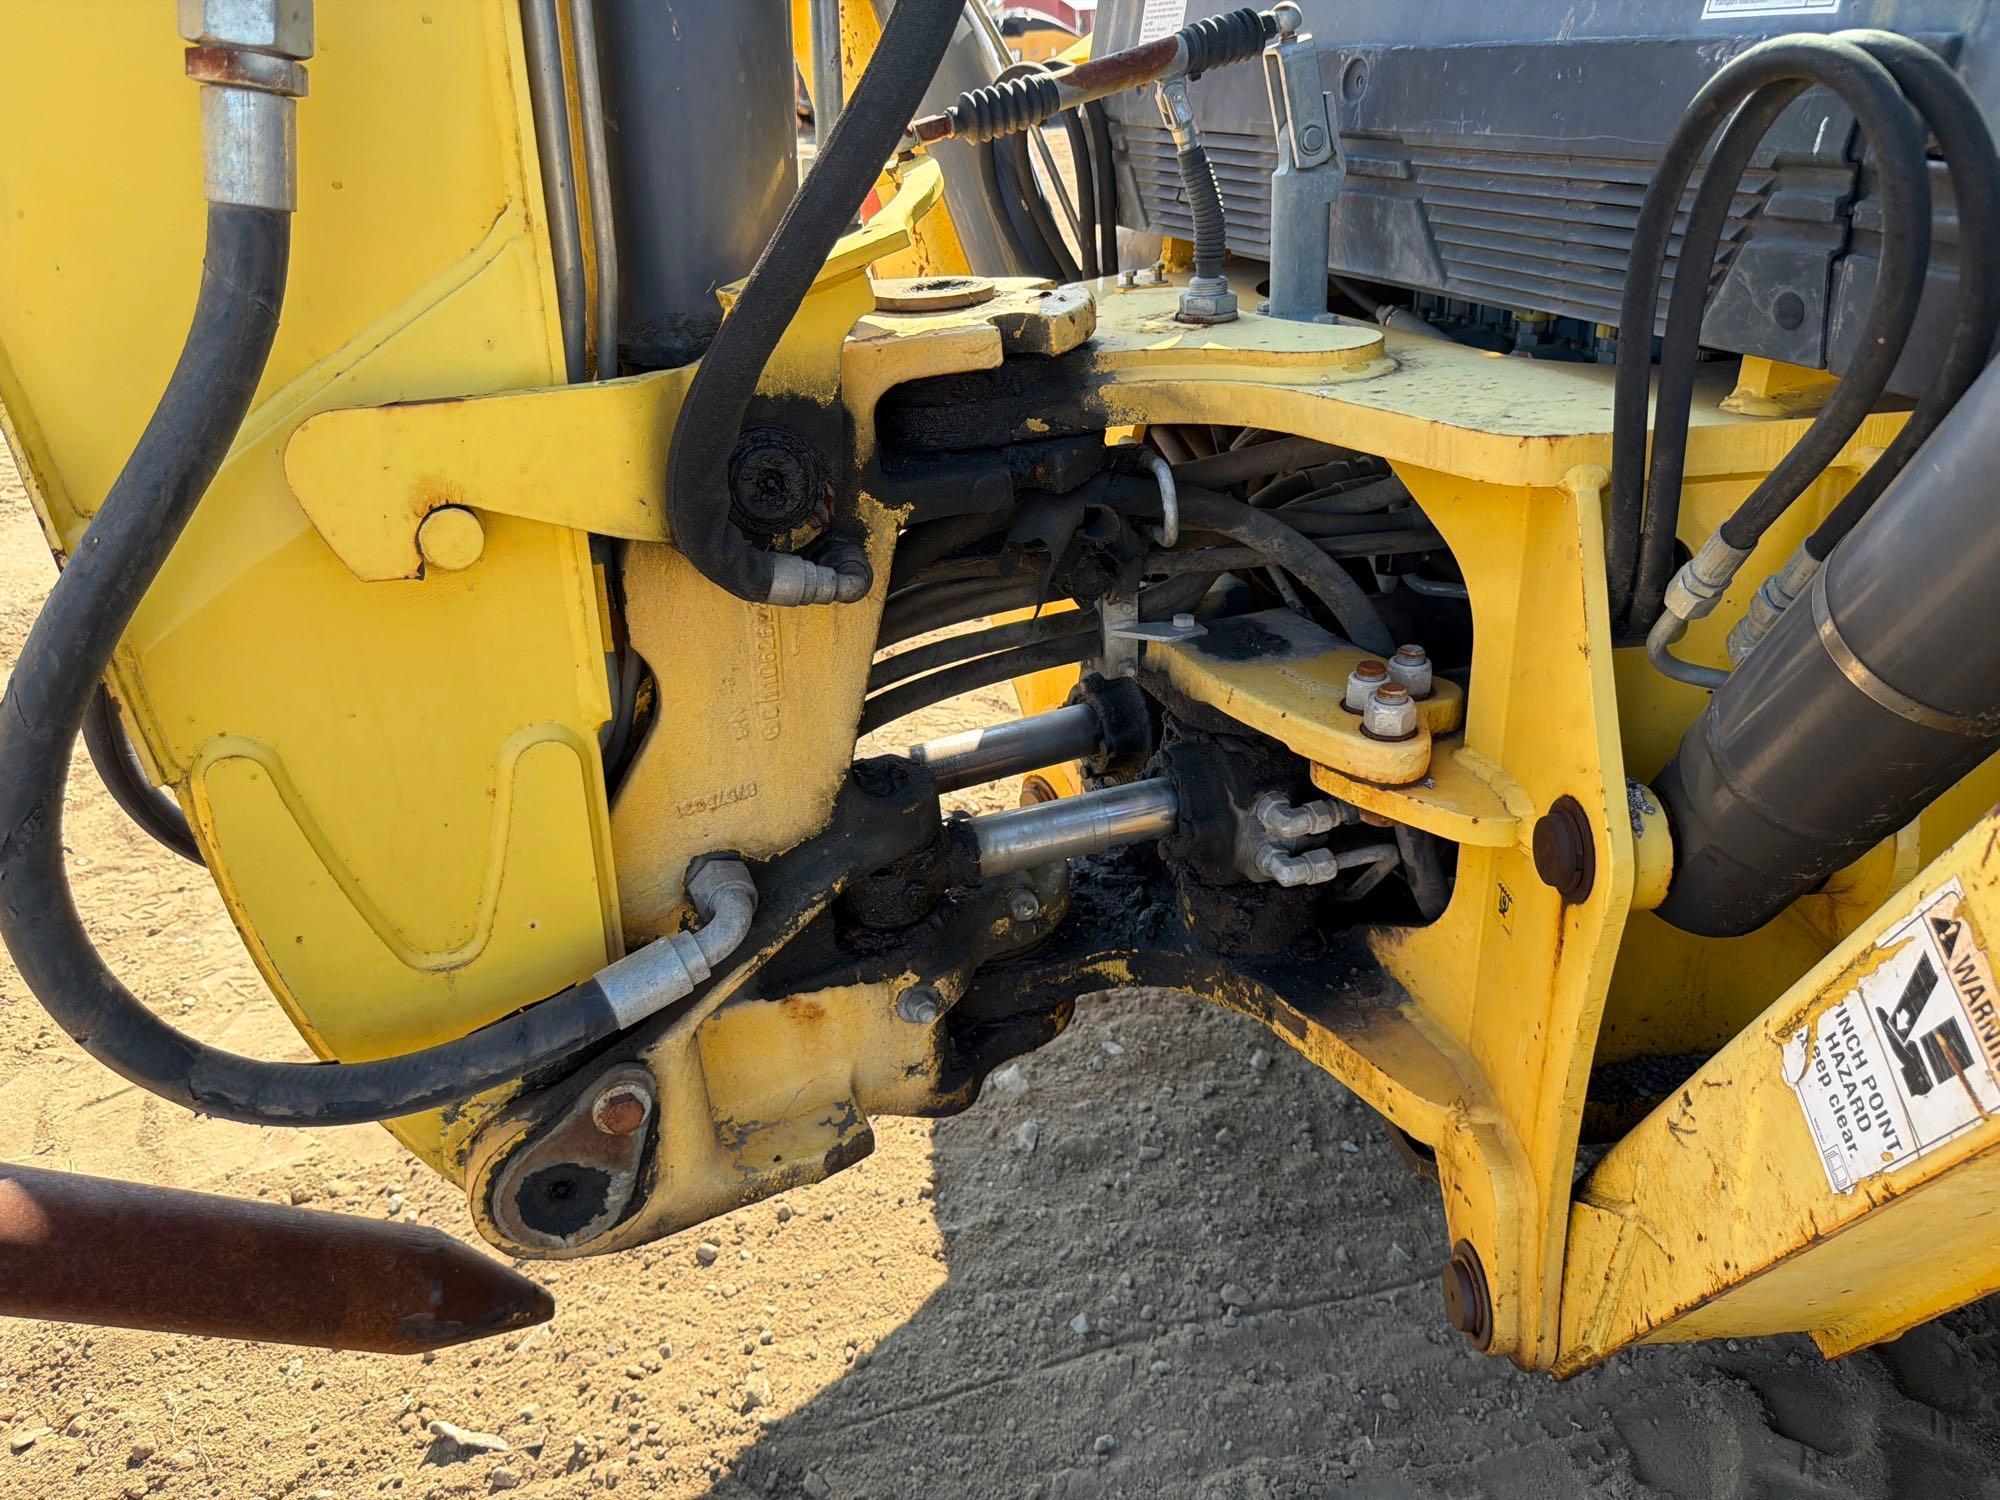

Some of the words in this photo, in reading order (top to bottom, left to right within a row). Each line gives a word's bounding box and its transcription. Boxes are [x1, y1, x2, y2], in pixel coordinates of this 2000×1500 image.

[1825, 1031, 1871, 1134] HAZARD
[1862, 1071, 1904, 1152] POINT
[1829, 1095, 1859, 1159] clear.
